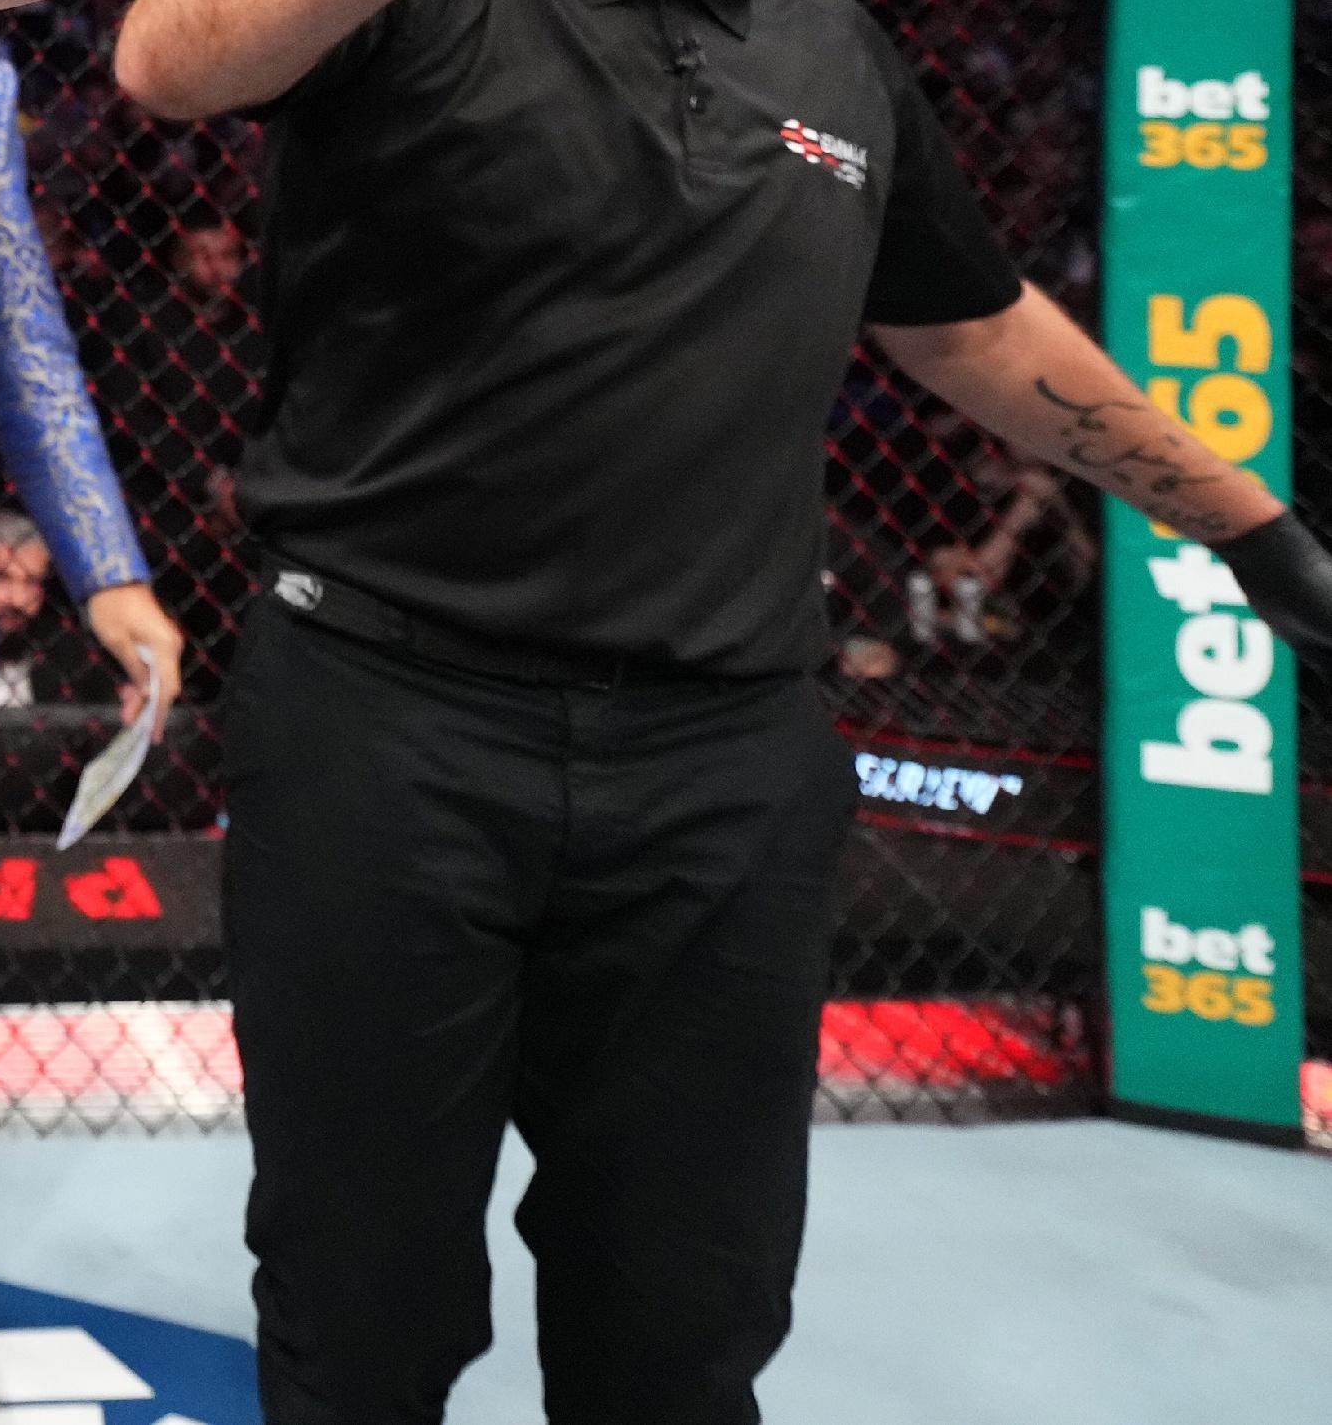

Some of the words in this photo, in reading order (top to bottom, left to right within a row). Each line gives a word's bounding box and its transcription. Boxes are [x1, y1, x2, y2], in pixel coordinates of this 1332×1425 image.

[1137, 65, 1270, 120] bet
[1138, 120, 1269, 172] 365
[1141, 904, 1275, 976] bet
[1142, 962, 1275, 1027] 365
